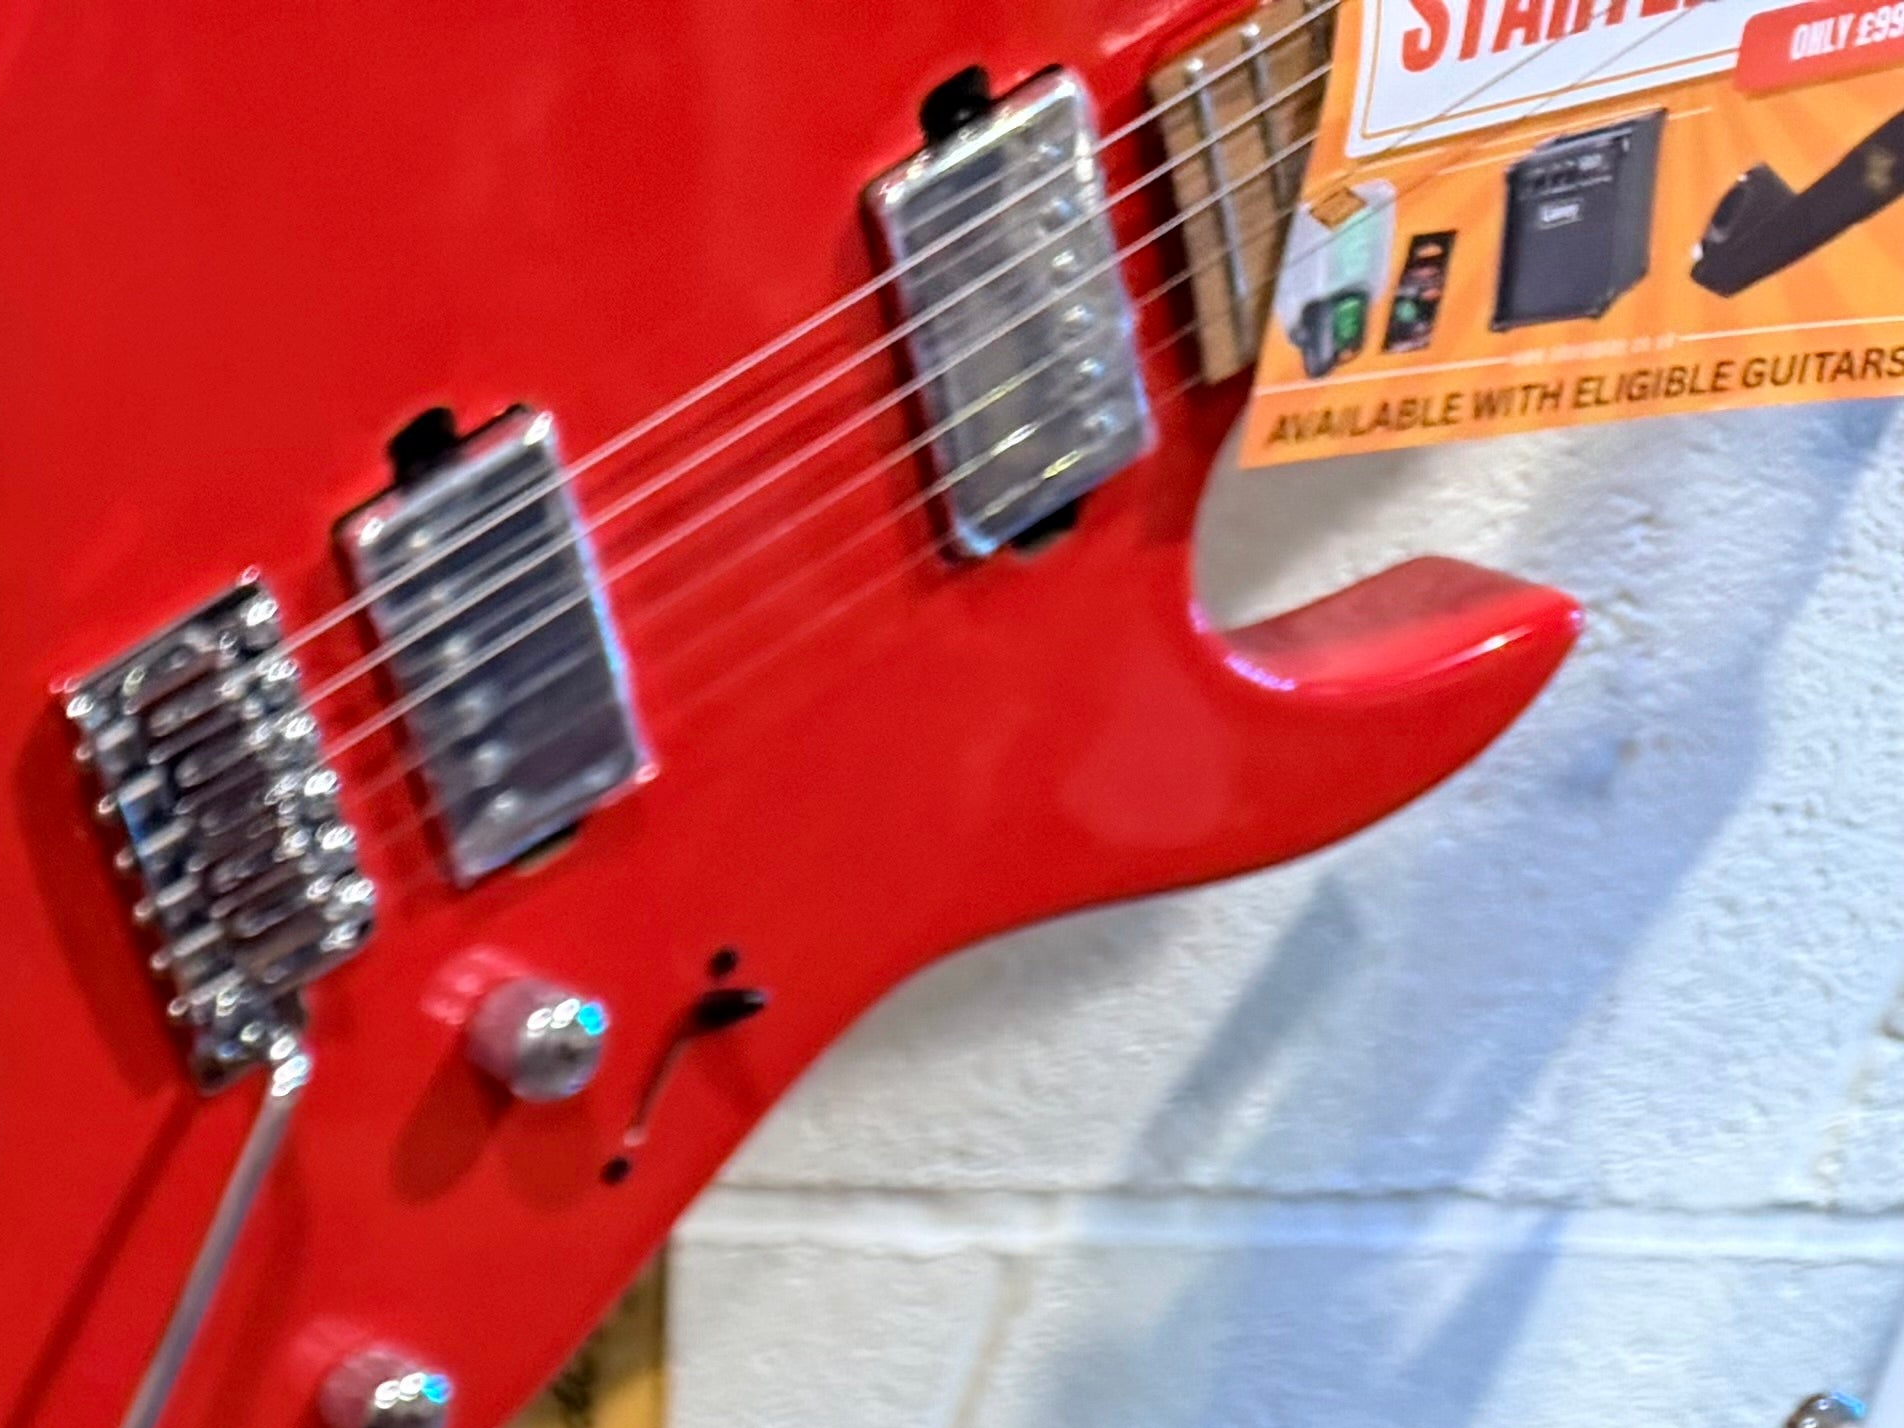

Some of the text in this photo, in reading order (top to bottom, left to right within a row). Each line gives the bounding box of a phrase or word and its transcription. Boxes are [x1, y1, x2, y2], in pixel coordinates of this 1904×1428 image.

[1790, 12, 1856, 61] ONLY
[1267, 346, 1904, 444] AVAILABLE WITH ELIGIBLE GUITARS
